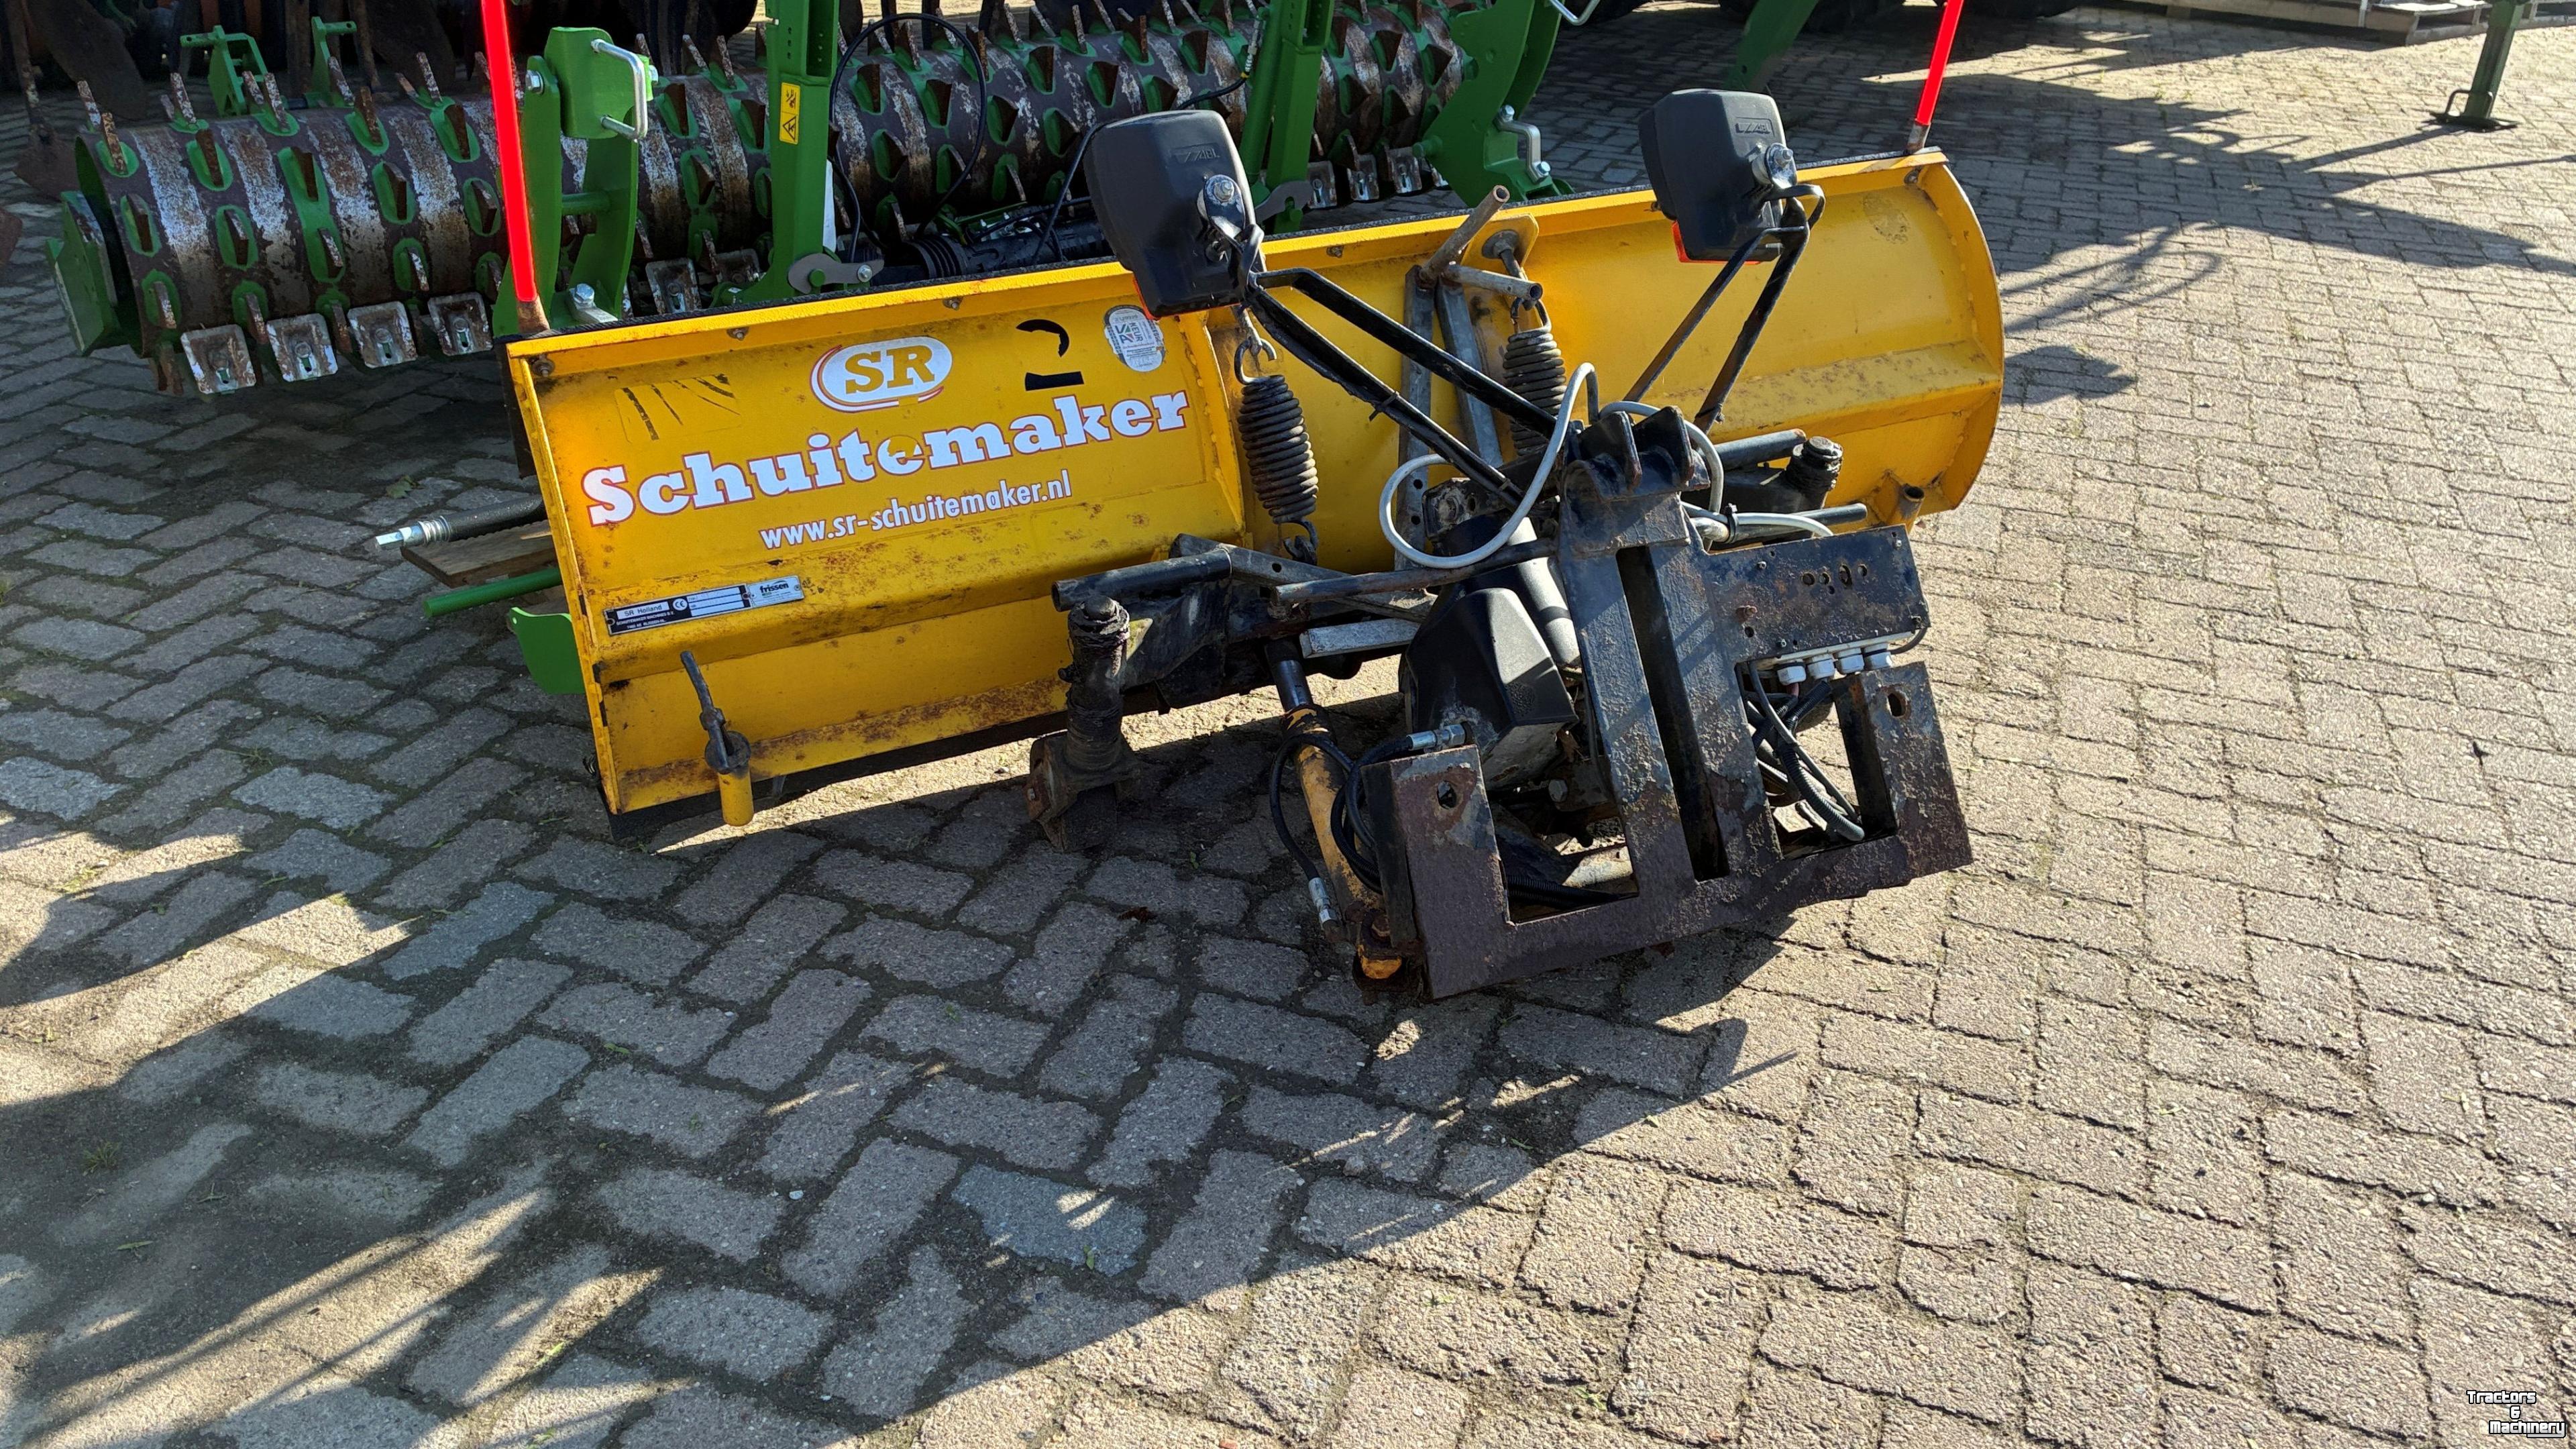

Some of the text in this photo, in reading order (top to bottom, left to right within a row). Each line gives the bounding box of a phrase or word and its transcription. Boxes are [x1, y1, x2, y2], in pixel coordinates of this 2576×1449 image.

[1016, 319, 1084, 391] 2
[1129, 322, 1144, 341] KEUR
[845, 343, 937, 394] SR
[582, 390, 1189, 527] Schuitemaker
[760, 470, 1073, 549] www.sr-schuitemaker.nl
[637, 604, 663, 614] Holland
[759, 582, 789, 594] frissen
